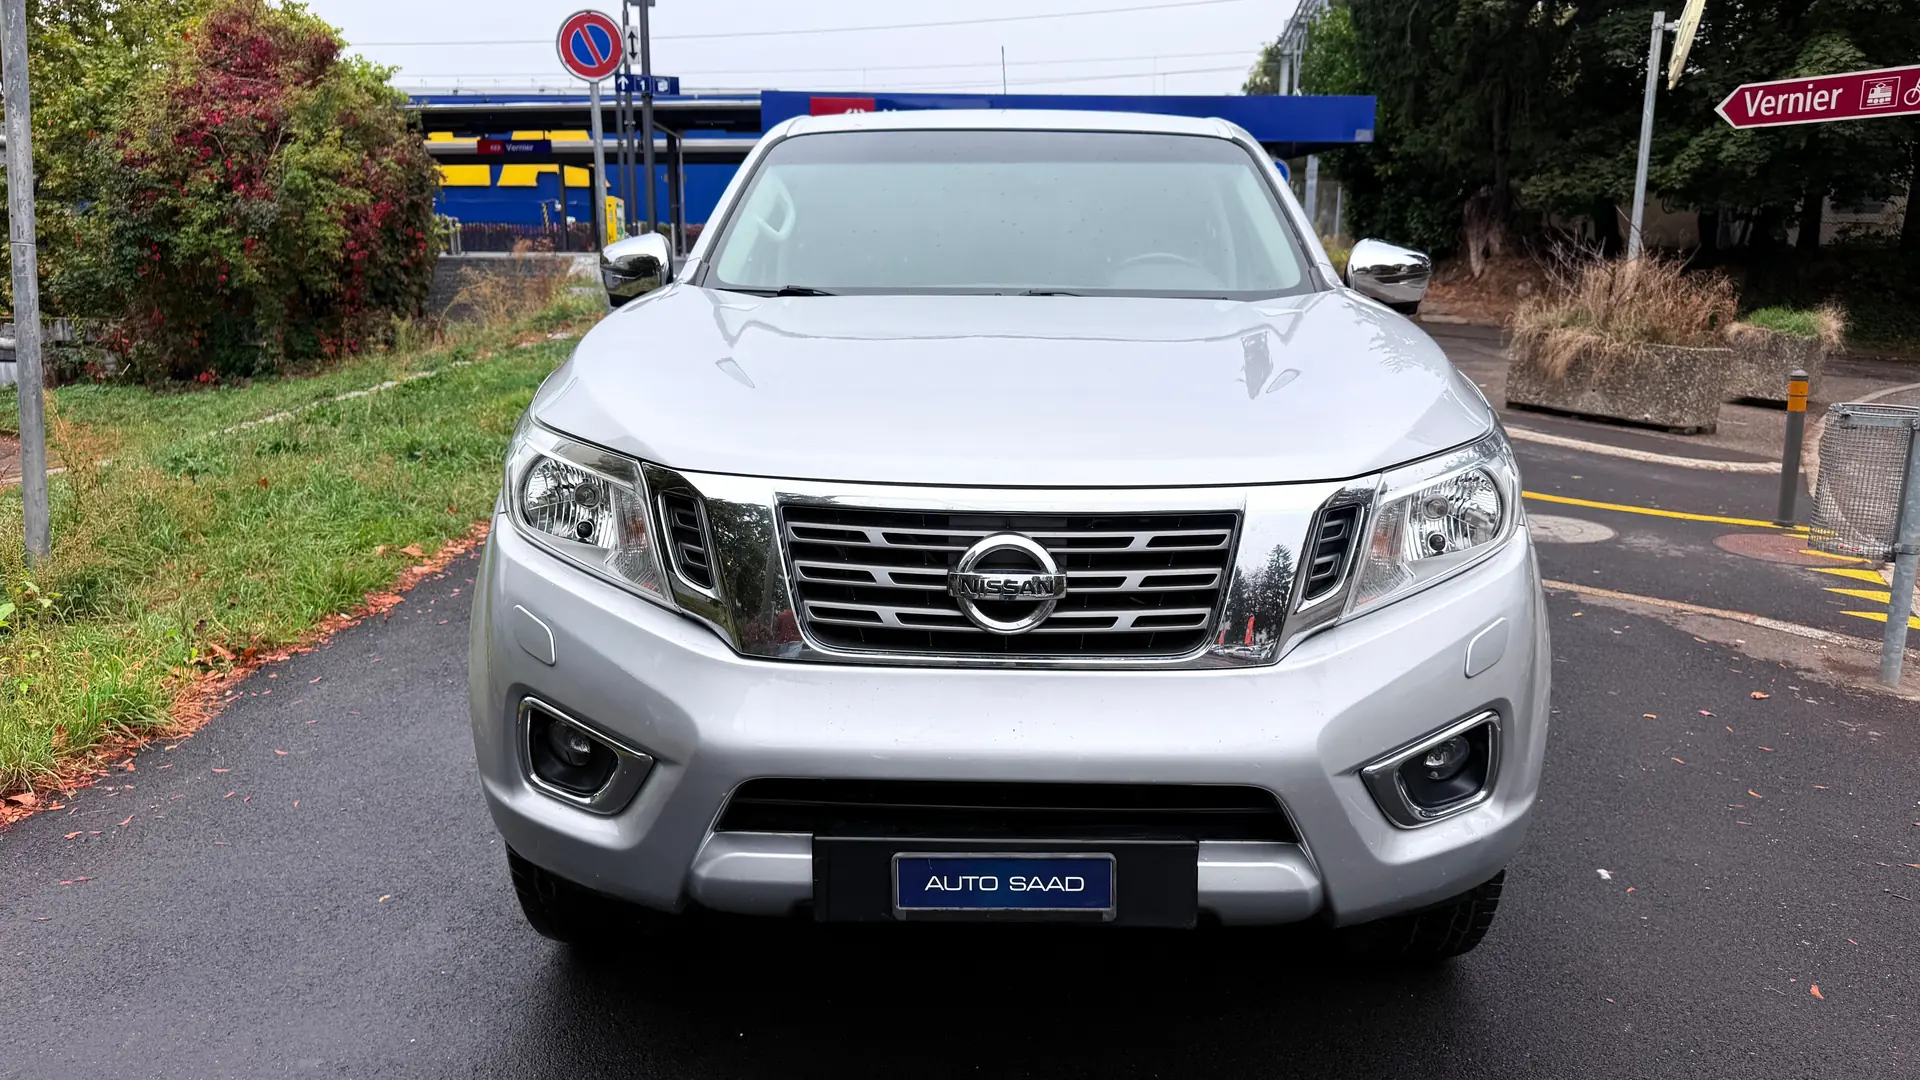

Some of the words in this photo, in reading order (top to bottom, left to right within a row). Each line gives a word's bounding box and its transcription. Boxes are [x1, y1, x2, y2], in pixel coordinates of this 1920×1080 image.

[639, 79, 646, 92] 1
[1744, 84, 1843, 118] Vernier
[505, 143, 534, 153] Vernier
[960, 578, 1054, 596] NISSAN
[924, 875, 999, 892] AUTO
[1008, 876, 1085, 892] SAAD
